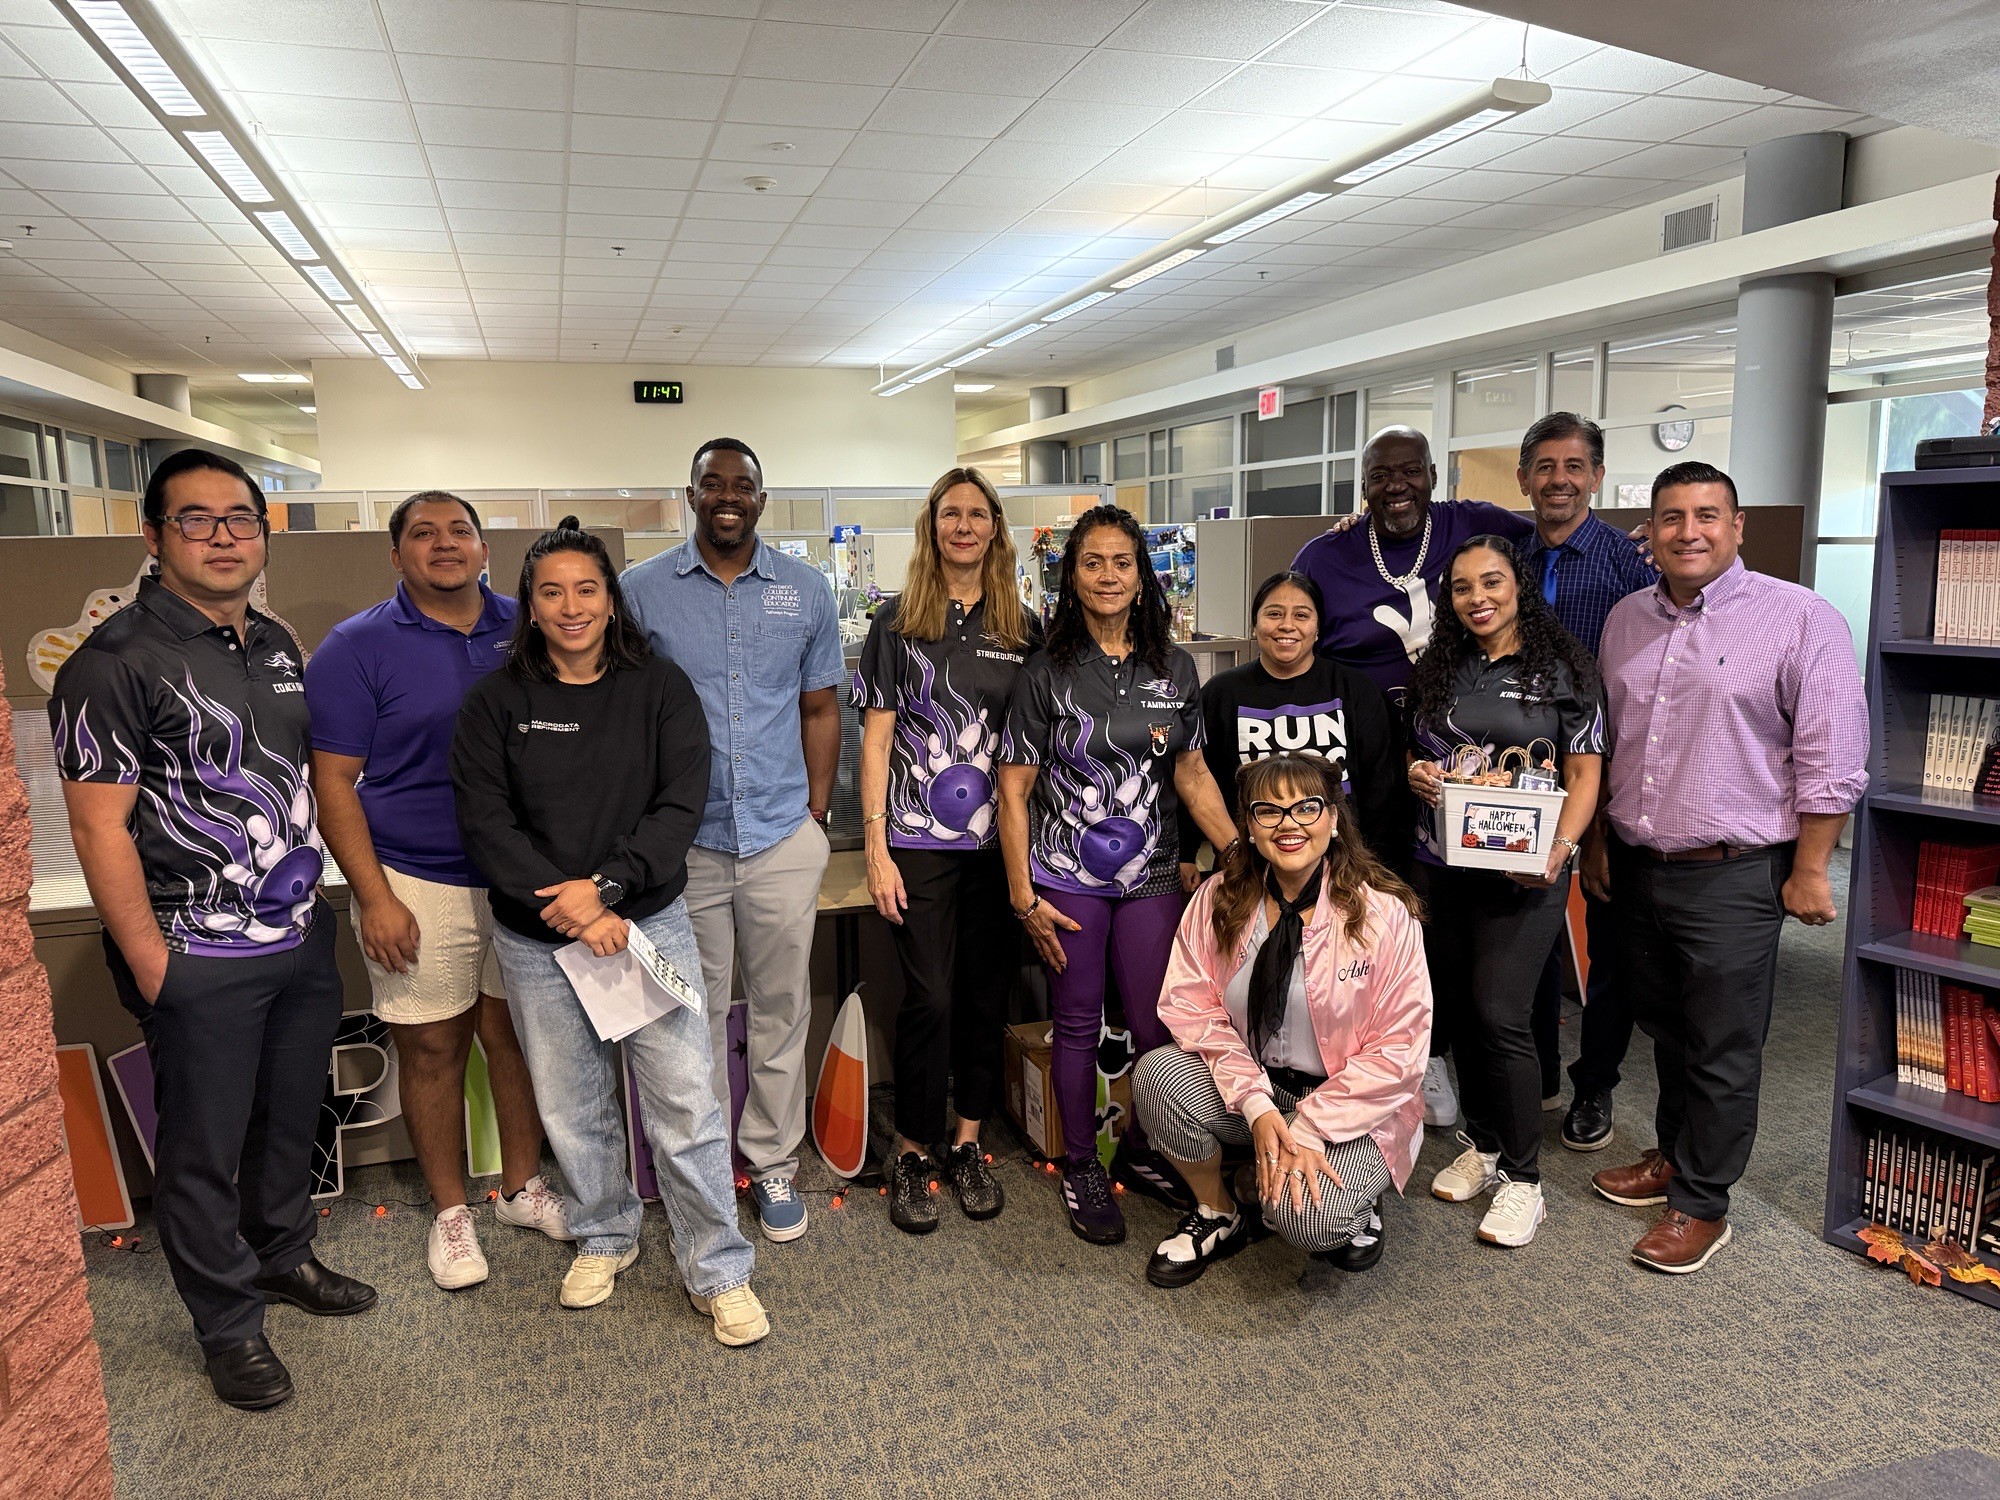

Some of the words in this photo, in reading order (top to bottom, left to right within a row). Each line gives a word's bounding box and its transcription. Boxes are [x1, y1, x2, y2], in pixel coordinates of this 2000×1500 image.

[643, 386, 680, 399] 11:47
[763, 587, 789, 595] COLLEGE
[761, 594, 801, 602] CONTINUING
[763, 600, 799, 608] EDUCATION
[976, 649, 1025, 665] STRIKEQUELINE
[272, 682, 297, 694] COACH
[1499, 691, 1522, 699] KING
[531, 720, 580, 728] MACRODATA
[531, 724, 580, 732] REFINEMENT
[1237, 709, 1347, 752] RUN
[1489, 810, 1516, 823] HAPPY
[1478, 819, 1526, 834] HALLOWEEN
[1338, 959, 1370, 982] Ash
[1977, 1037, 1985, 1053] YOU
